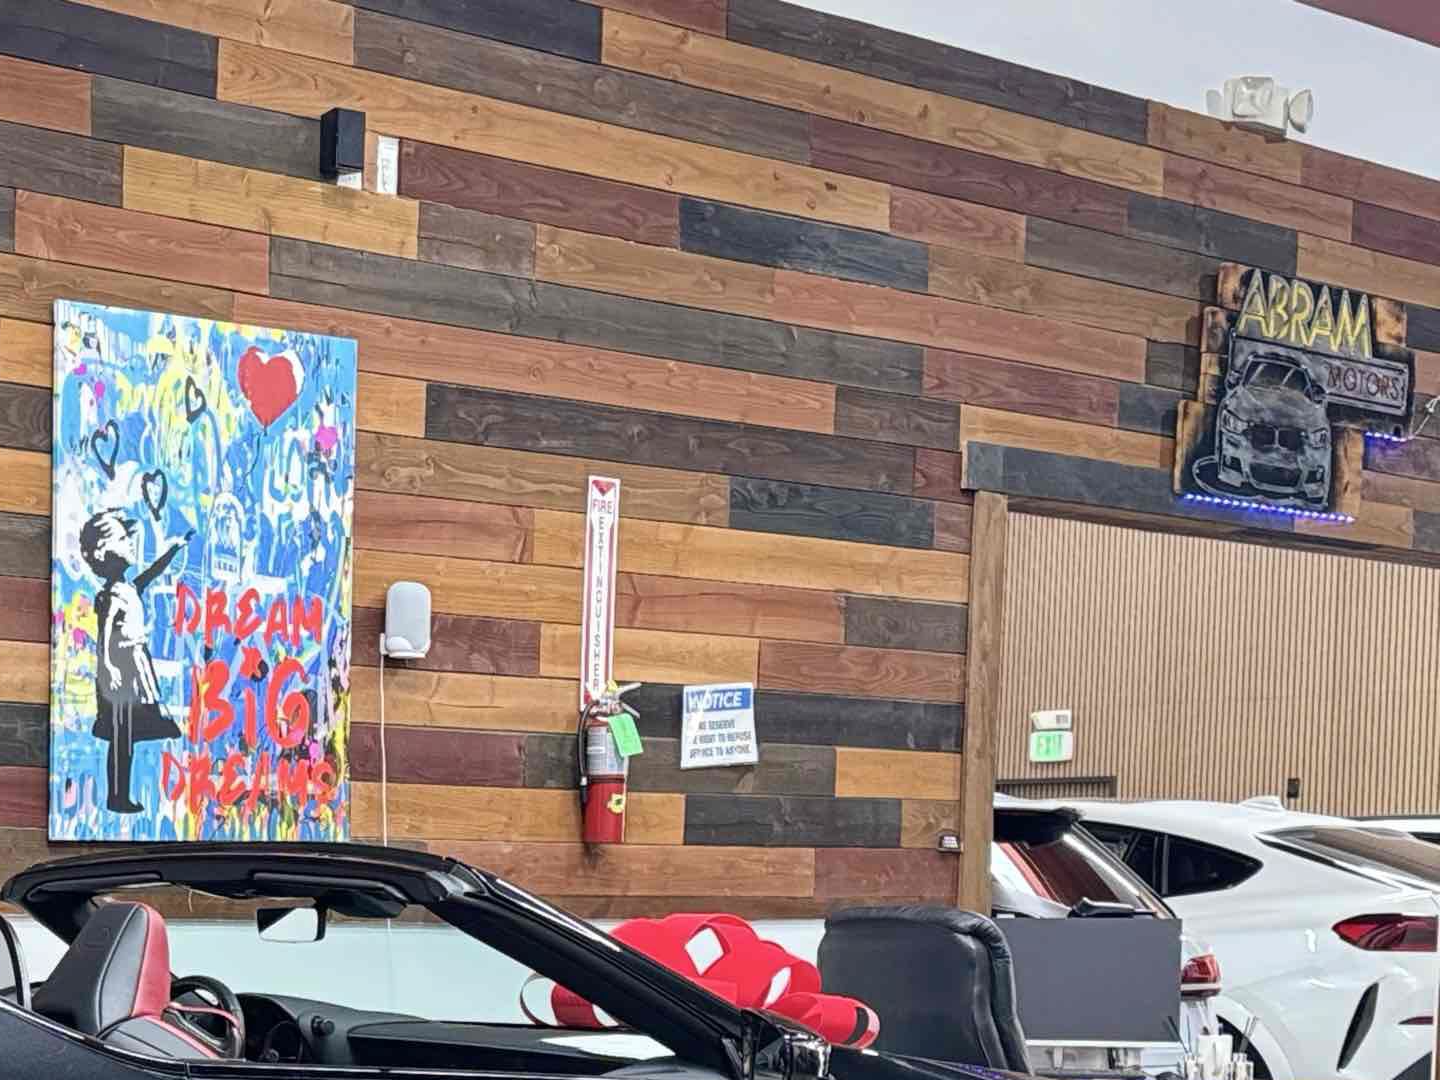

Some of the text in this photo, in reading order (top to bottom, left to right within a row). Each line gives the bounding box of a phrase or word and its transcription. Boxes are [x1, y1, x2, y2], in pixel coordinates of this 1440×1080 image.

[1236, 267, 1373, 360] ABRAM
[1326, 363, 1401, 400] MOTORS
[592, 498, 614, 514] FIRE
[175, 581, 324, 648] DREAM
[688, 691, 742, 710] NOTICE
[162, 751, 336, 818] DREAMS
